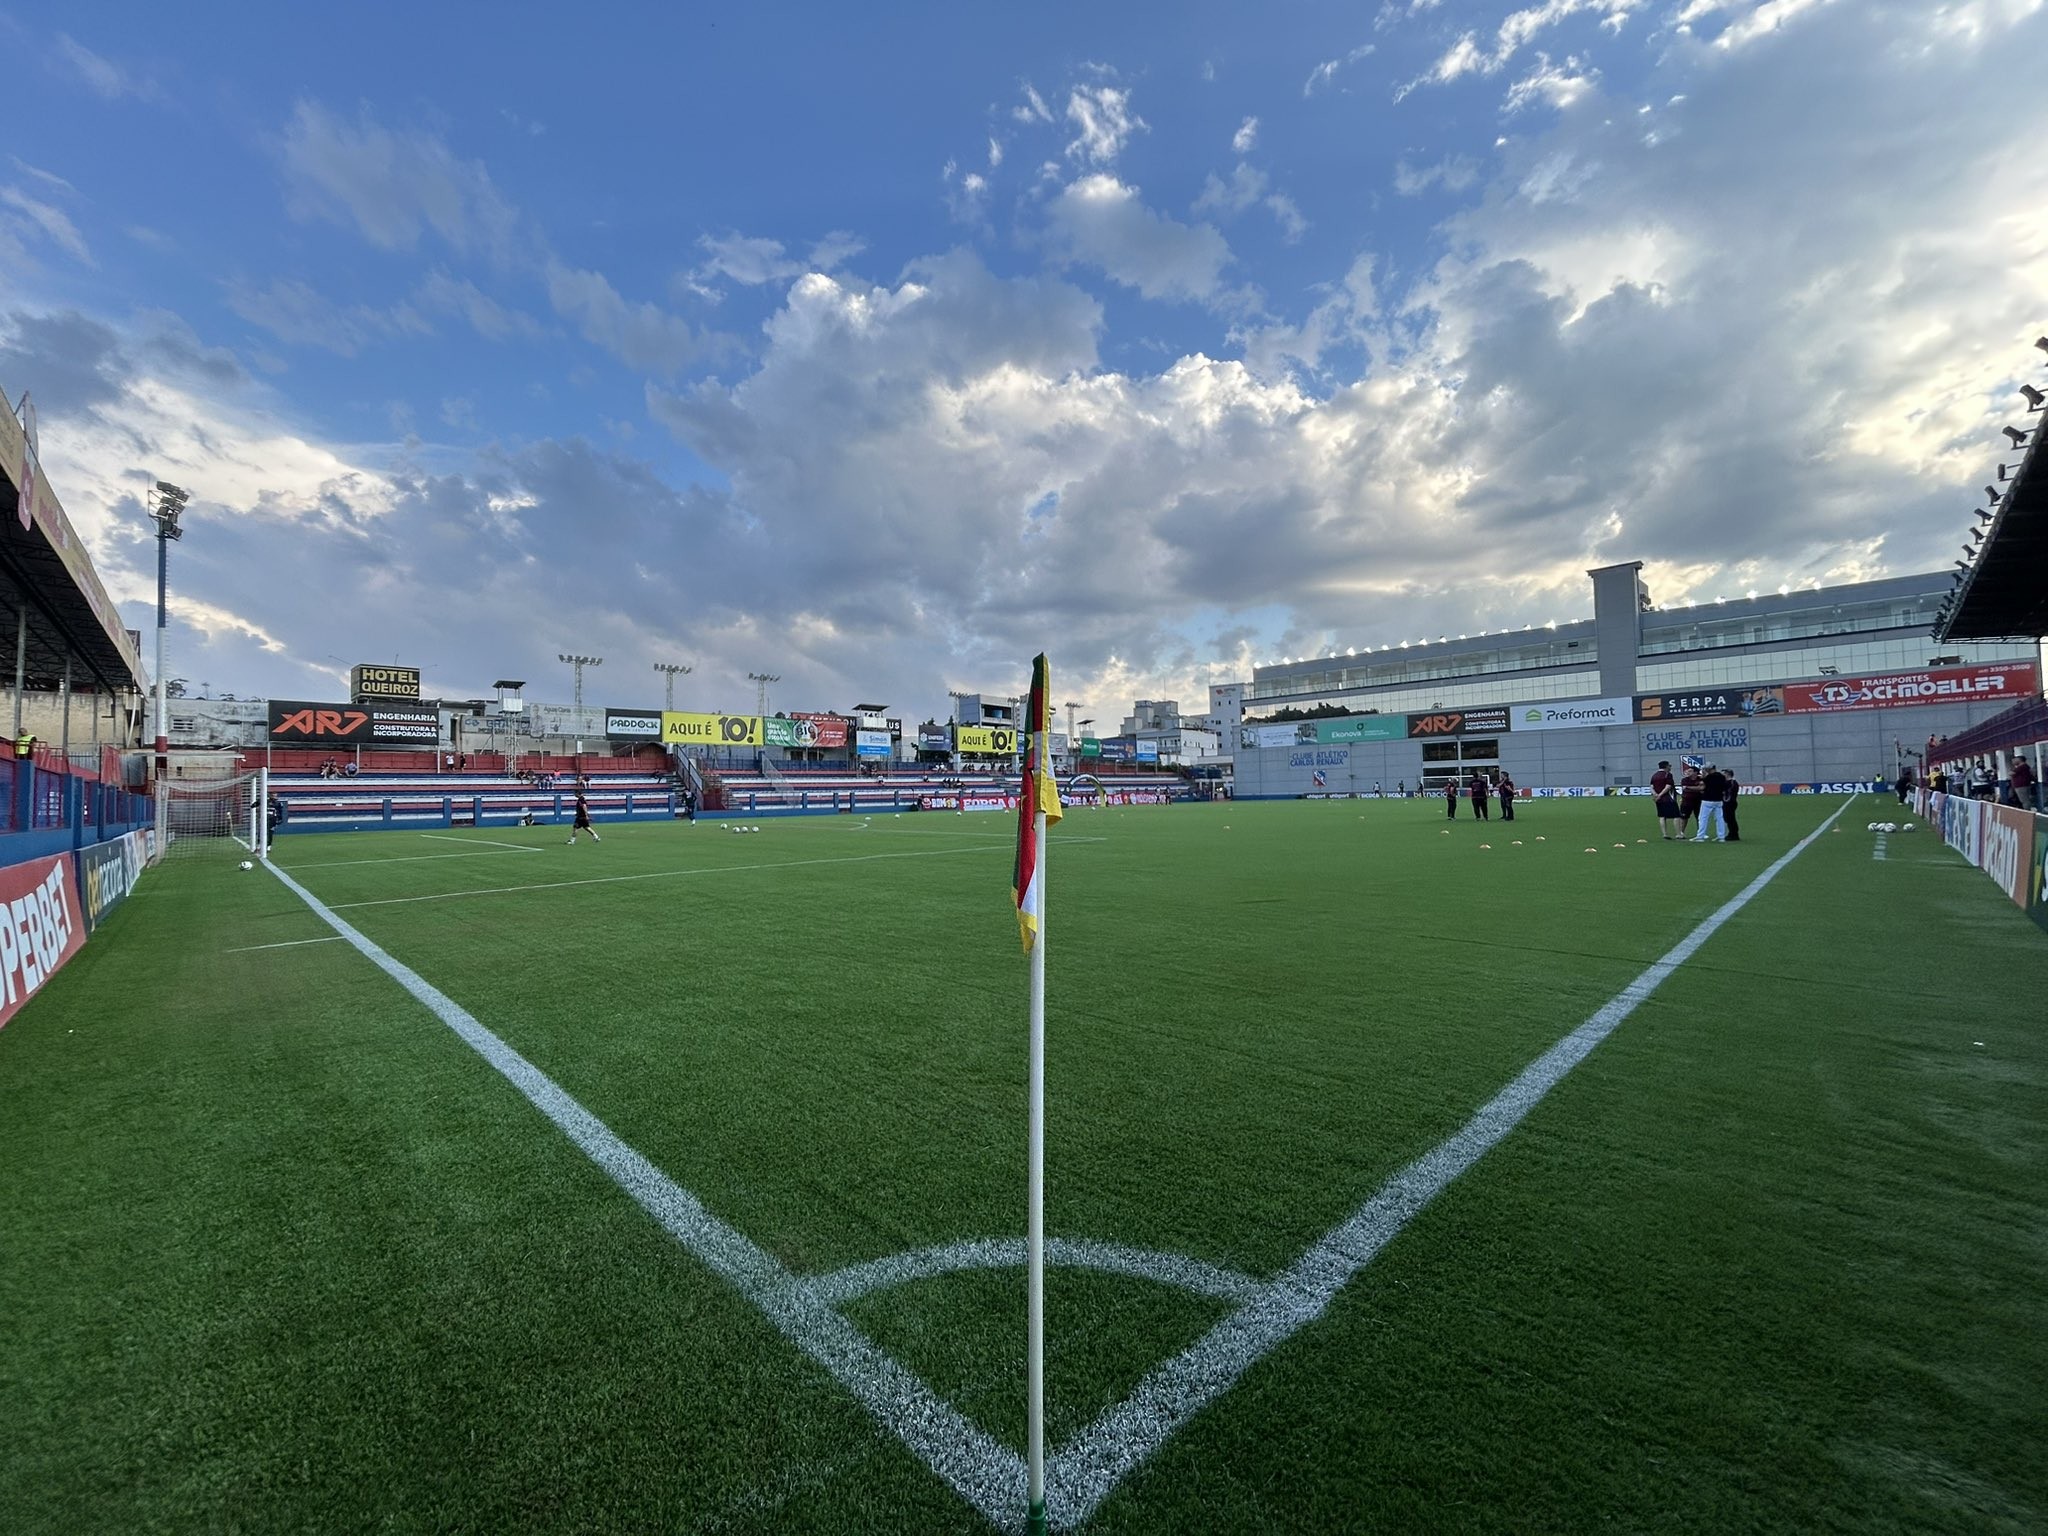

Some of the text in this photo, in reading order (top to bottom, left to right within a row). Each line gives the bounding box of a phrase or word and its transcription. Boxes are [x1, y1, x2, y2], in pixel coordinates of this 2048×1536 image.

[362, 668, 418, 683] HOTEL
[1860, 674, 1930, 687] TRANSPORTES
[361, 681, 418, 695] QUEIROZ
[1824, 686, 1849, 702] TS
[1861, 676, 2005, 701] SCHMOELLER
[1669, 696, 1726, 708] SERPA
[373, 712, 437, 722] ENGENHARIA
[1465, 711, 1506, 719] ENGENHARIA
[1547, 707, 1615, 721] Preformat
[272, 709, 369, 735] AR7
[373, 724, 431, 732] CONSTRUTORA
[611, 719, 658, 729] PADDOCK
[1411, 714, 1462, 734] AR7
[670, 717, 757, 744] AQUI É 10!
[1331, 731, 1362, 739] Ekonova
[1647, 728, 1746, 742] CLUBE ATLÉTICO
[962, 737, 982, 746] AQUI
[983, 735, 987, 746] É
[991, 732, 1013, 751] 10!
[1647, 738, 1747, 751] CARLOS RENAUX
